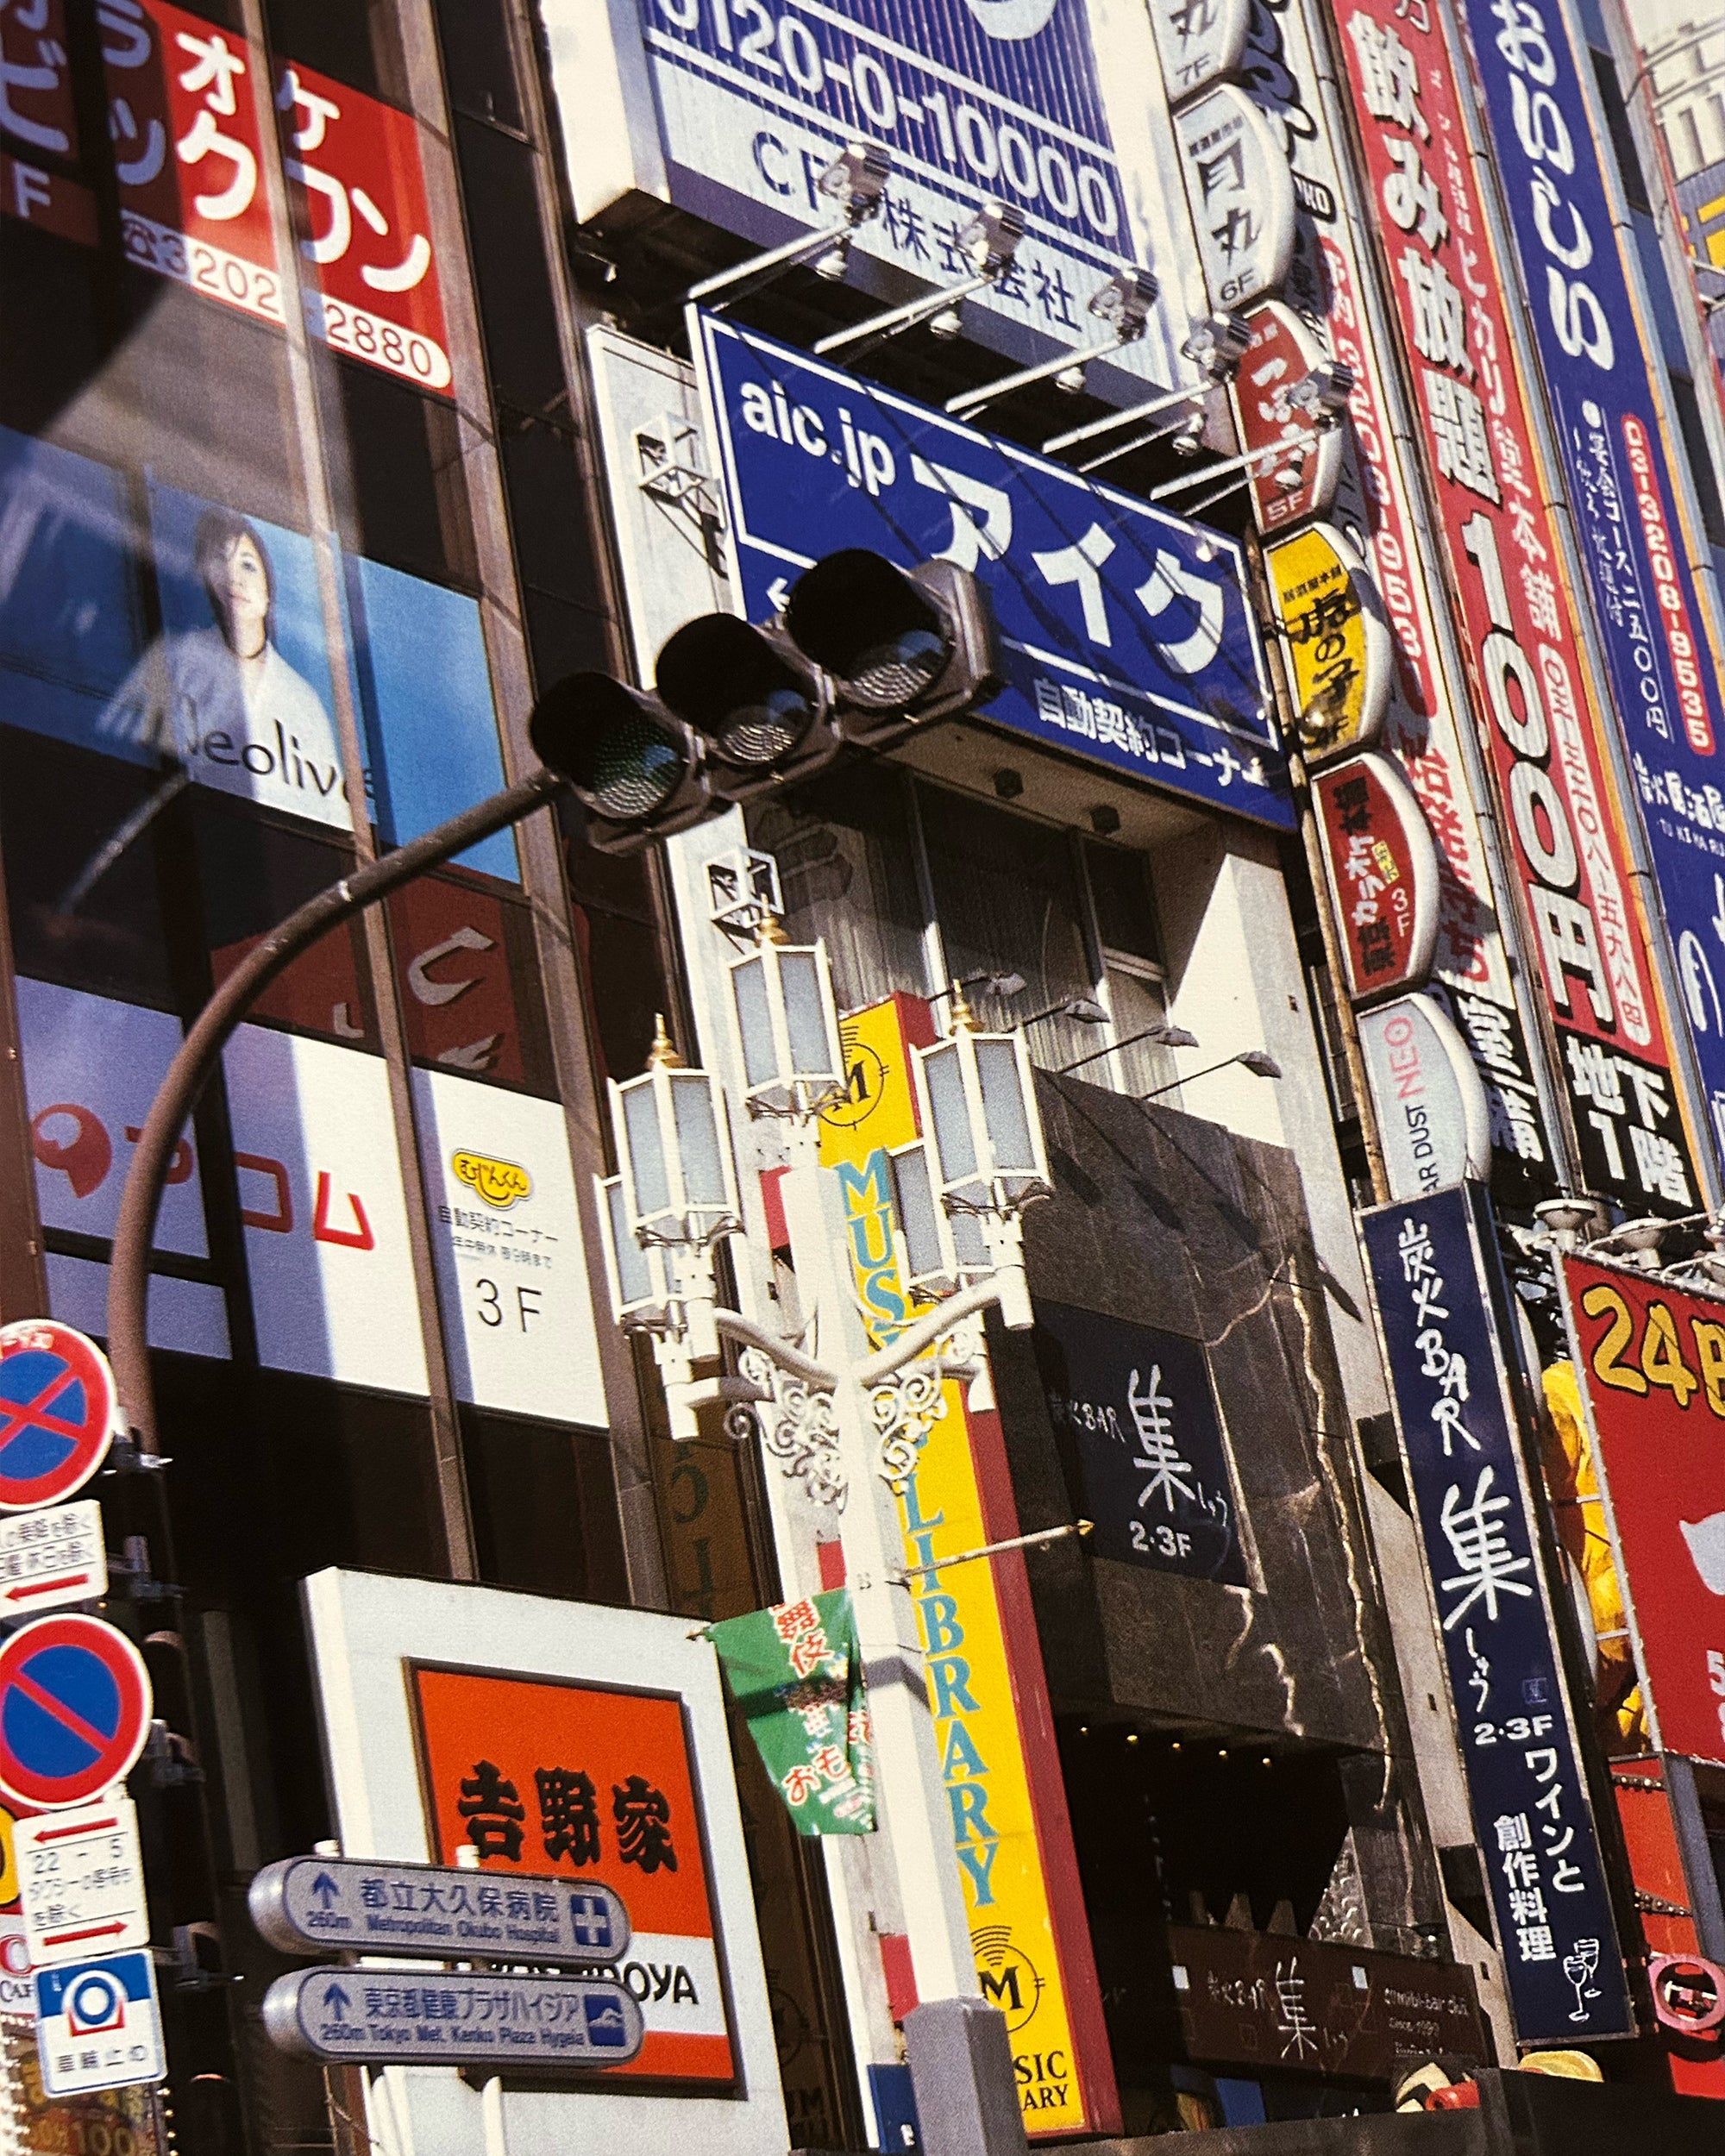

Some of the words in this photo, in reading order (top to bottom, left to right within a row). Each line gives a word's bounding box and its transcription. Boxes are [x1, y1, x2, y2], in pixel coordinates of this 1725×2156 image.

[1175, 52, 1210, 86] 7F
[1220, 268, 1255, 302] 6F
[739, 378, 895, 497] aic.jp
[1266, 491, 1304, 522] 5F
[912, 454, 1225, 674] アイク
[1390, 887, 1411, 938] 3F
[1383, 1014, 1426, 1100] NEO
[1404, 1104, 1434, 1159] DUST
[458, 1758, 680, 1874] 吉野家
[1524, 1746, 1586, 1894] ワインと
[361, 1877, 559, 1923] 都立大久保病院
[1493, 1810, 1558, 1964] 創作料理
[362, 1985, 580, 2023] 東京都健康プラザハイジア
[368, 2023, 412, 2045] Tokyo
[499, 2027, 537, 2046] Plaza
[1016, 2052, 1068, 2085] SIC
